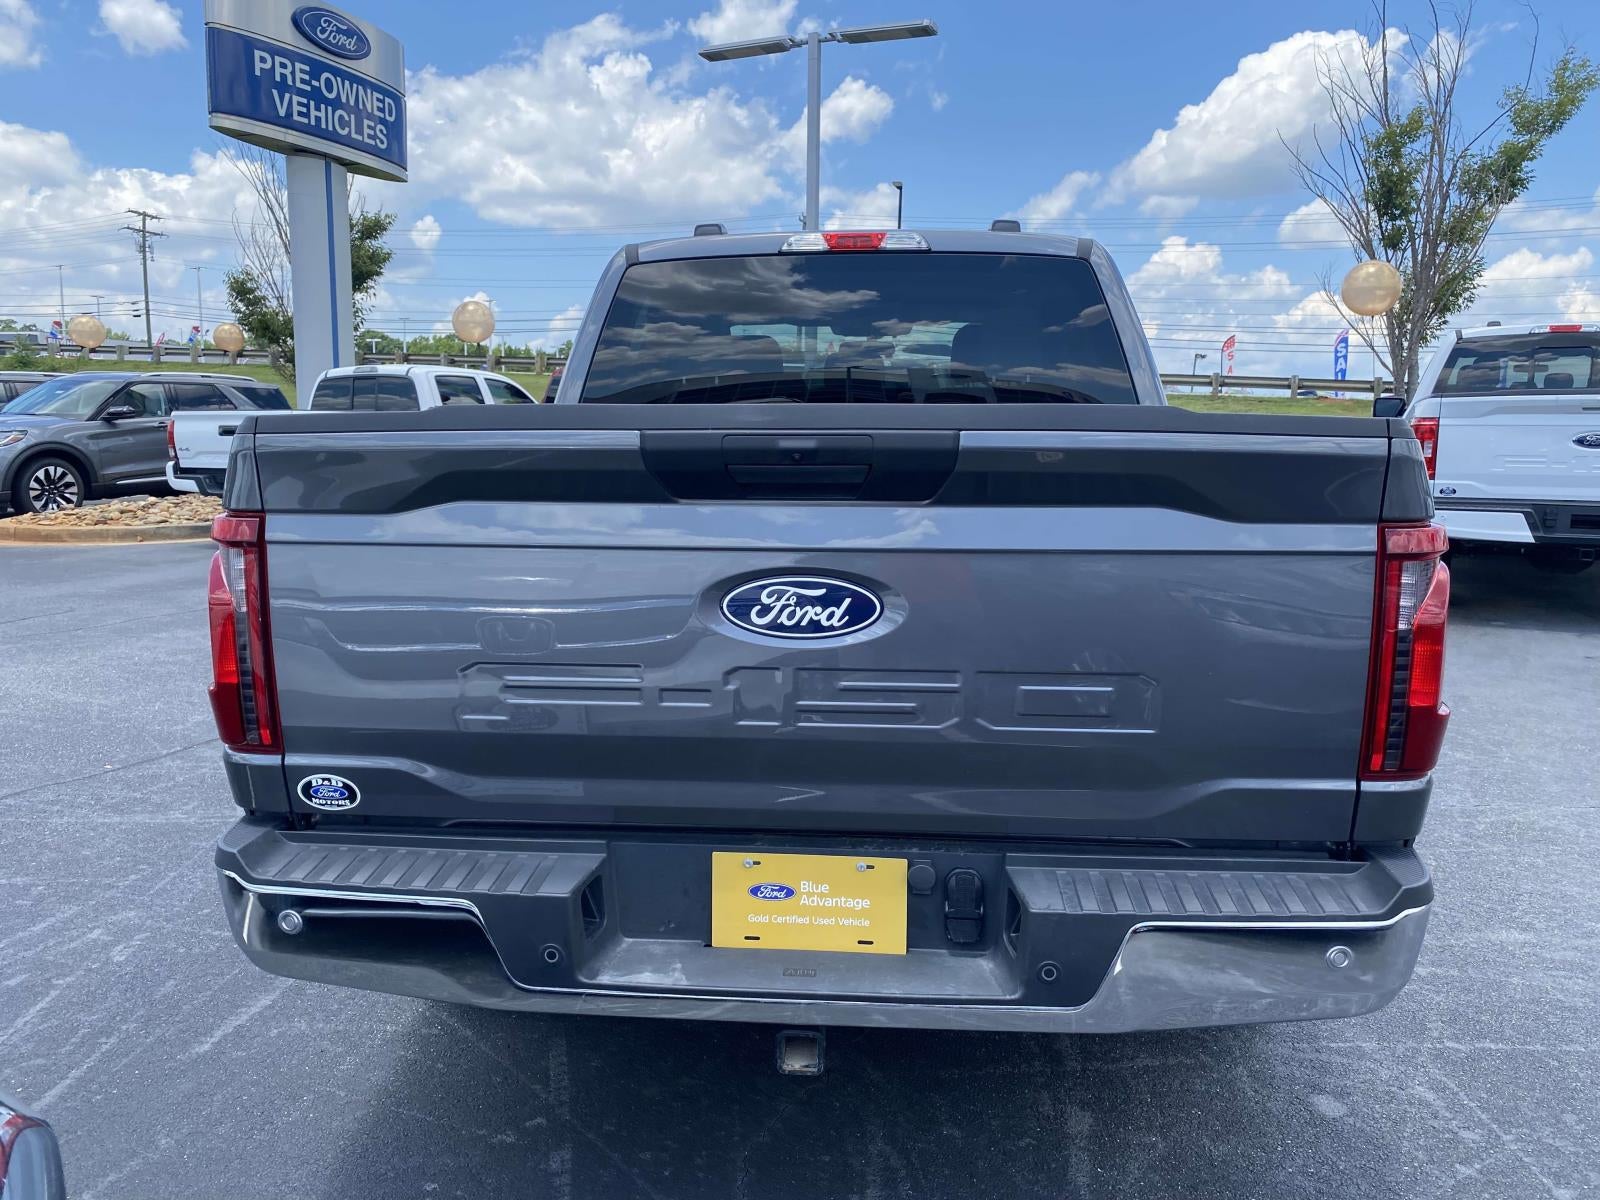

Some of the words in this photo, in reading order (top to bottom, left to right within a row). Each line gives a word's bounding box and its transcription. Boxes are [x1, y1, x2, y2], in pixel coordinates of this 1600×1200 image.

[317, 16, 357, 50] Ford
[253, 49, 396, 122] PRE-OWNED
[272, 89, 388, 149] VEHICLES
[750, 585, 852, 627] Ford
[457, 662, 1161, 735] F-150
[311, 778, 343, 787] D&D
[317, 787, 340, 798] Ford
[311, 798, 350, 806] MOTORS
[757, 885, 786, 898] Ford
[800, 881, 829, 893] Blue
[800, 895, 870, 910] Advantage
[748, 914, 769, 923] Gold
[771, 915, 809, 925] Certified
[812, 916, 835, 925] Used
[837, 917, 870, 927] Vehicle
